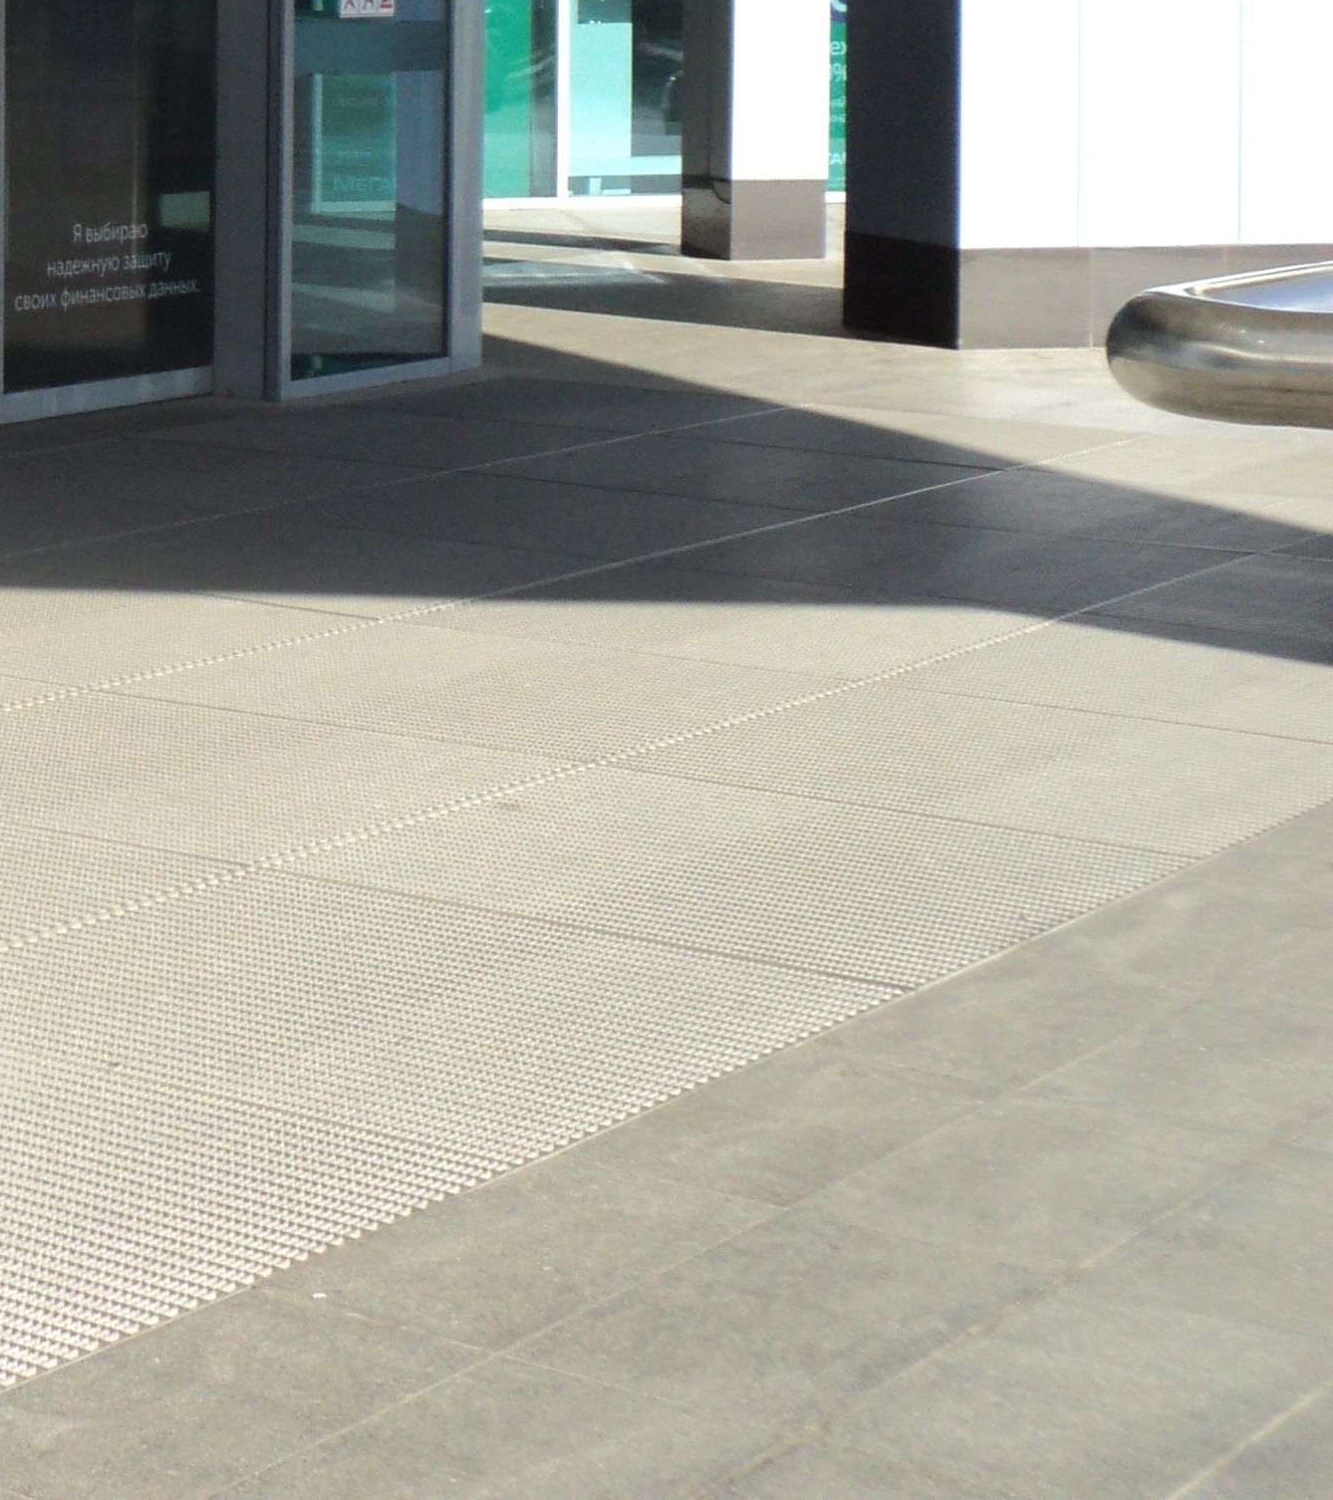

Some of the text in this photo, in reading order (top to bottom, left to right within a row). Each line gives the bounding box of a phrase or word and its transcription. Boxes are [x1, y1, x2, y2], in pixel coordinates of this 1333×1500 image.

[73, 222, 148, 243] Я выбираю
[47, 251, 171, 278] надежную защиту
[15, 293, 56, 311] своих
[61, 284, 146, 312] финансовых
